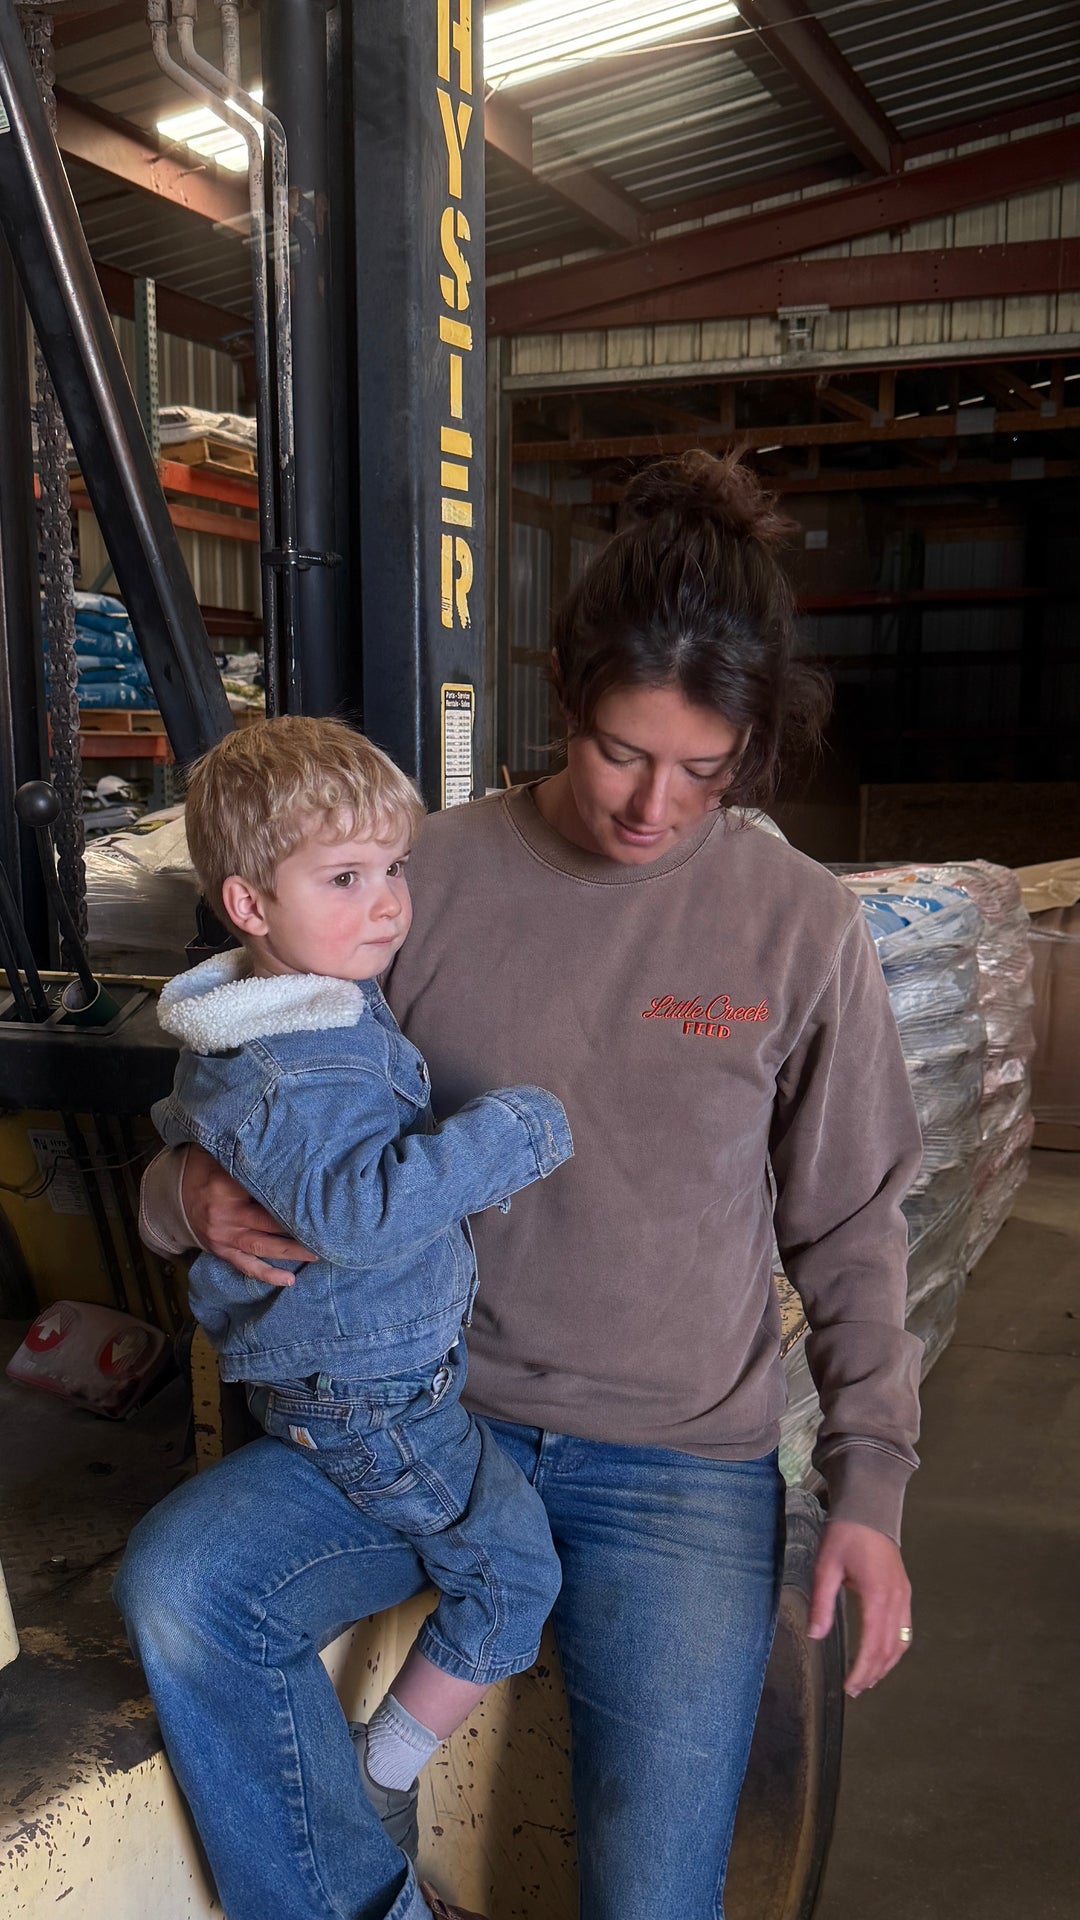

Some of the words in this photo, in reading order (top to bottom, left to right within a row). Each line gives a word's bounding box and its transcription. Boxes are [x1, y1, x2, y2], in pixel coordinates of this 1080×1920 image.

[437, 0, 473, 630] HYSTER
[641, 994, 705, 1020] Little
[705, 994, 769, 1022] Creek
[682, 1020, 732, 1039] FEED
